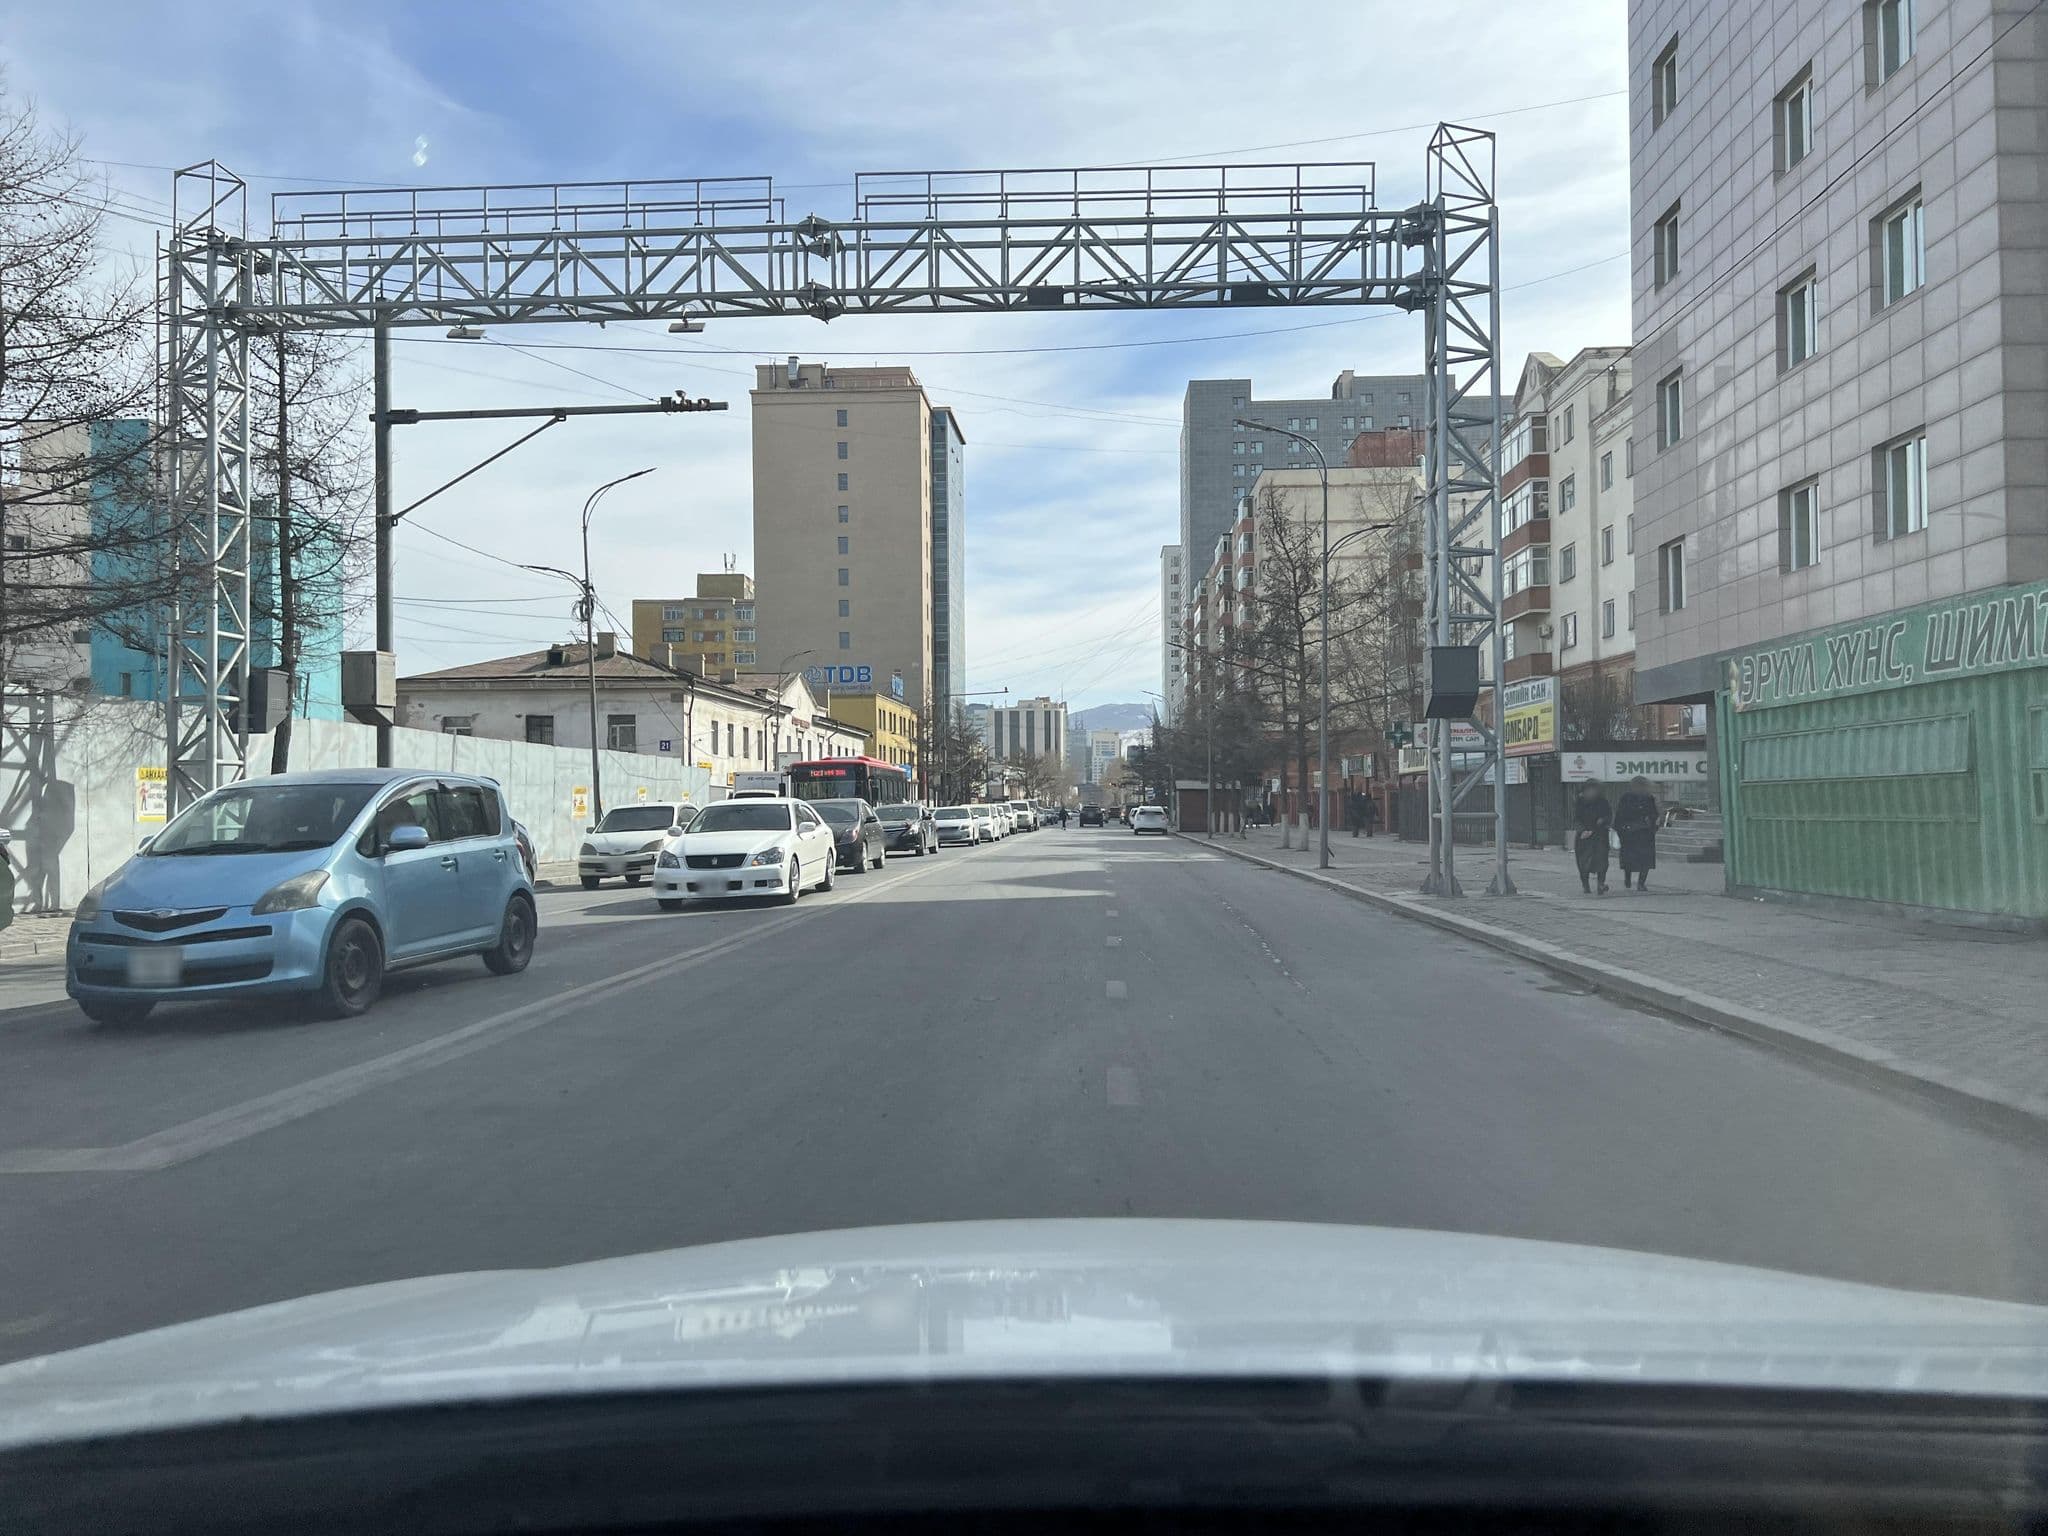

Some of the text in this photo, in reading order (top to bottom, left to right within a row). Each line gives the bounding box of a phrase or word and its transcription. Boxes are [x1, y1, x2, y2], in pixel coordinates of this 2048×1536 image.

[823, 666, 873, 684] TDB
[1742, 642, 1827, 704] ЭРҮҮЛ
[1530, 682, 1546, 700] САН
[1504, 715, 1539, 744] ОМБАРД
[661, 742, 669, 750] 21
[1616, 759, 1707, 774] ЭМИЙН С
